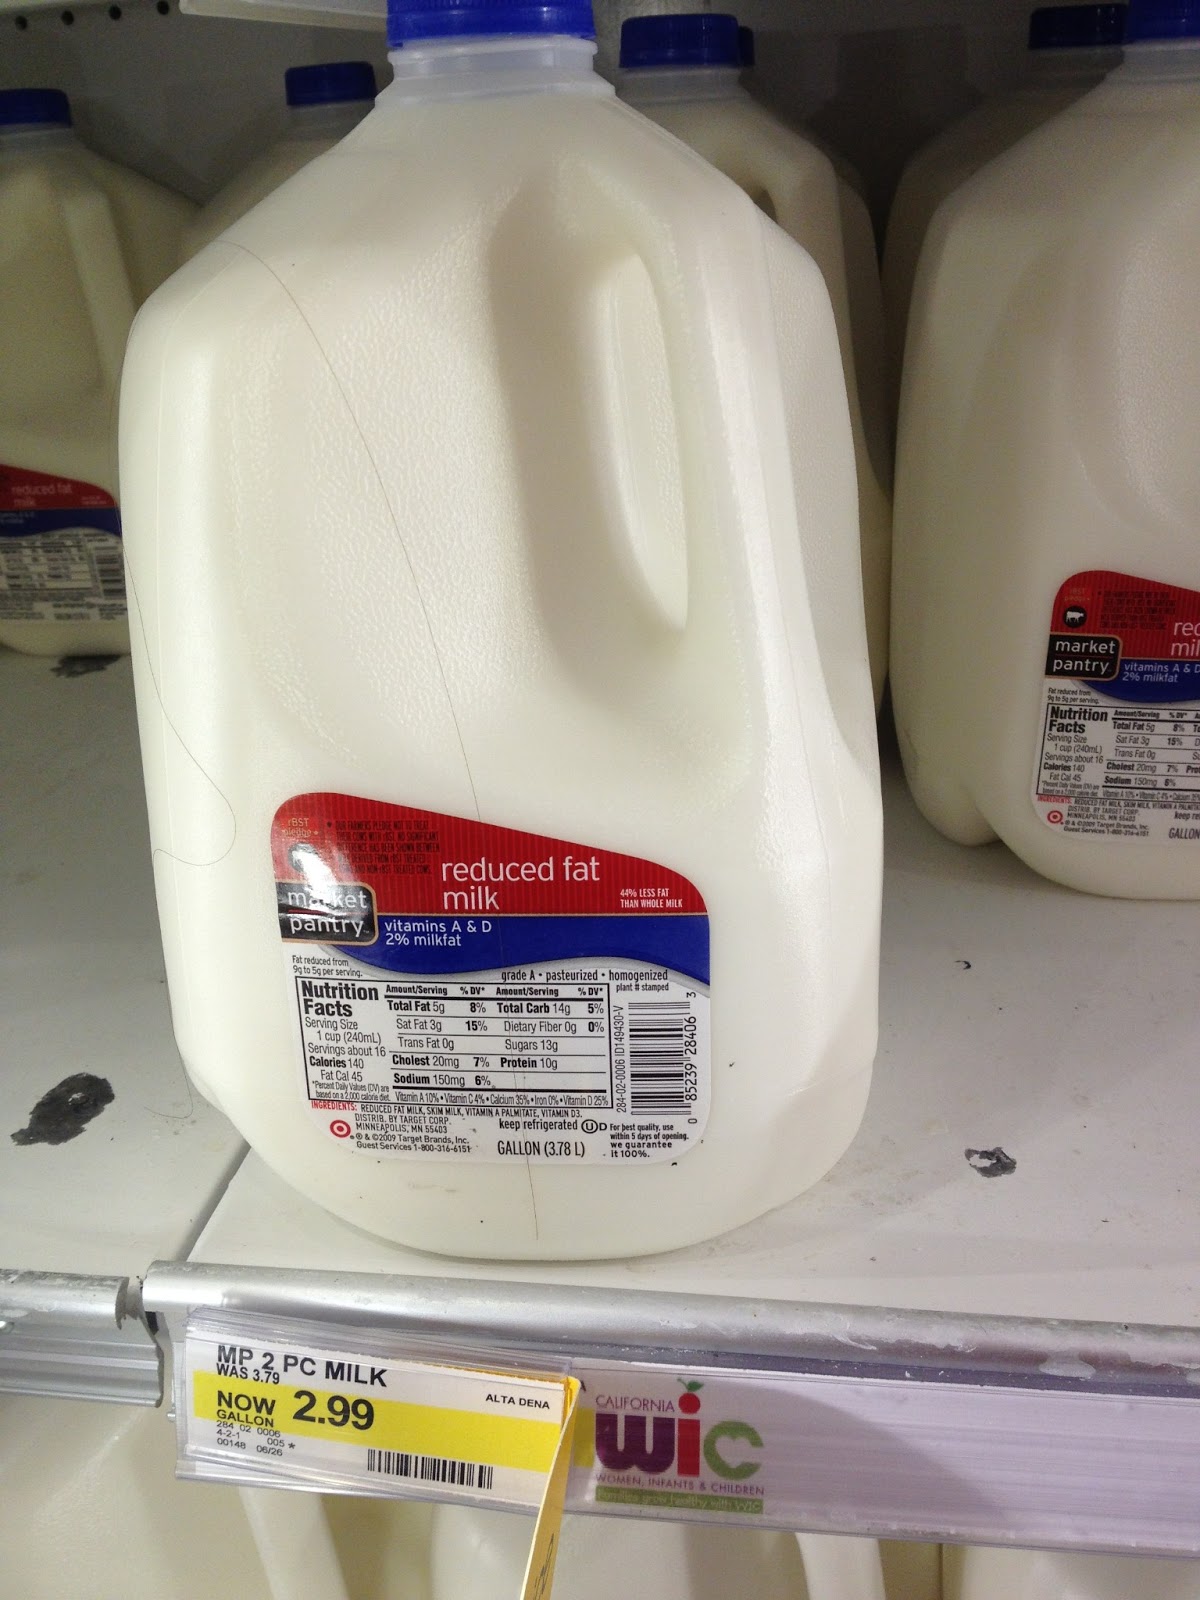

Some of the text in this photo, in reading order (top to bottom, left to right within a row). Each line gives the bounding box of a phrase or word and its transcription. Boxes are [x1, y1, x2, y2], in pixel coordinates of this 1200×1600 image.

[11, 484, 72, 495] reduced fat
[1056, 641, 1115, 654] market
[1053, 659, 1109, 674] pantry
[1124, 663, 1169, 672] vitamins
[1173, 664, 1180, 672] A
[1183, 664, 1190, 672] &
[1123, 672, 1178, 682] 2% milkfat
[1050, 706, 1108, 721] Nutrition
[1049, 720, 1085, 733] Facts
[1047, 733, 1087, 743] Serving Size
[1116, 735, 1128, 743] Sat
[1129, 736, 1141, 744] Fat
[1044, 762, 1084, 772] Calories 140
[442, 857, 554, 881] reduced
[563, 856, 600, 881] fat
[288, 890, 367, 908] maket
[443, 886, 499, 910] milk
[620, 888, 669, 897] 44% LESS FAT
[620, 899, 682, 908] THAN WHOLE MILK
[290, 917, 364, 937] pantry
[385, 921, 491, 933] vitamins A & D
[386, 934, 461, 947] 2% milkfat
[293, 955, 348, 966] Fat reduced from
[293, 966, 302, 975] 9g
[312, 968, 321, 976] 5g
[323, 968, 334, 976] per
[336, 968, 363, 977] serving.
[501, 970, 667, 982] grade A pasteurized homogenized
[301, 981, 378, 1001] Nutrition
[386, 985, 447, 996] Amount/Serving
[496, 987, 559, 998] Amount/Serving
[616, 983, 669, 993] plant stamped
[304, 998, 352, 1017] Facts
[387, 1000, 486, 1014] Total Fat 5g 8%
[497, 1003, 604, 1016] Total Carb 14g 5%
[305, 1017, 358, 1031] Serving Size
[397, 1019, 487, 1032] Sat Fat 3g 15%
[504, 1021, 604, 1034] Dietary Fiber 0g 0%
[317, 1031, 381, 1045] 1 cup (240mL)
[684, 1016, 697, 1055] 28406
[308, 1043, 386, 1057] Servings about 16
[398, 1036, 454, 1051] Trans Fat 0g
[505, 1039, 558, 1052] Sugars 13g
[310, 1056, 364, 1069] Calories 140
[393, 1055, 489, 1069] Cholest 20mg 7%
[501, 1058, 558, 1071] Protein 10g
[613, 1005, 627, 1113] 284-02-0006 ID149430-V
[321, 1070, 363, 1082] Fat Cal 45
[394, 1073, 491, 1087] Sodium 150mg 6%
[684, 1063, 698, 1101] 85239
[312, 1101, 357, 1111] INGREDIENTS:
[356, 1122, 447, 1134] MINNEAPOLIS, MN 55403
[500, 1119, 577, 1132] keep refrigerated
[399, 1135, 426, 1144] Target
[429, 1136, 453, 1145] Brands,
[624, 1141, 672, 1149] guarantee
[356, 1141, 471, 1153] Guest Services 1-800-316-6151
[498, 1141, 585, 1157] GALLON (3.78 L)
[620, 1150, 650, 1158] 100%.
[217, 1345, 388, 1388] MP 2 PC MILK
[216, 1363, 280, 1385] WAS 3.79
[485, 1393, 550, 1410] ALTA DENA
[596, 1395, 675, 1412] CALIFORNIA
[217, 1390, 374, 1430] NOW 2.99
[217, 1409, 274, 1428] GALLON
[216, 1420, 281, 1438] 284 02 0006
[217, 1428, 285, 1447] 4-2-1 005
[217, 1437, 283, 1456] 00148 06/26
[596, 1474, 764, 1495] WOMEN, INFANTS & CHILDREN
